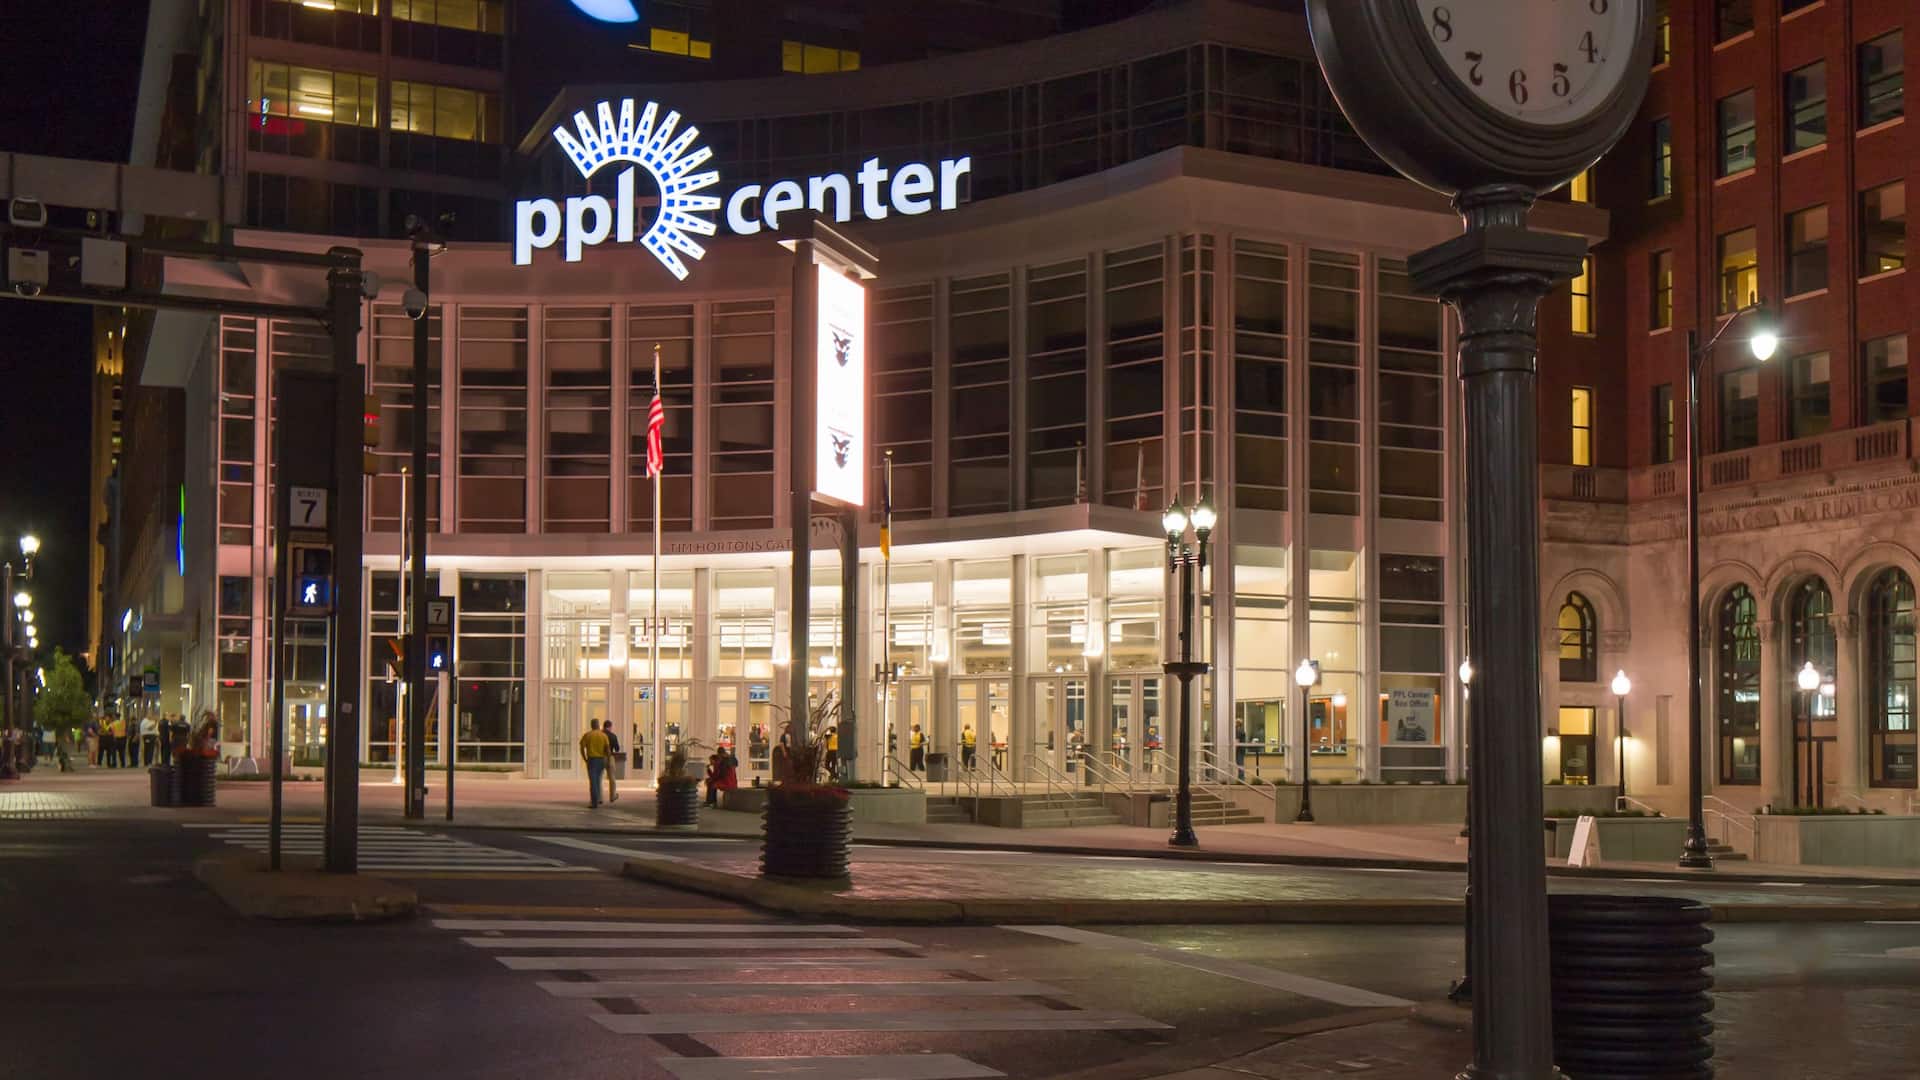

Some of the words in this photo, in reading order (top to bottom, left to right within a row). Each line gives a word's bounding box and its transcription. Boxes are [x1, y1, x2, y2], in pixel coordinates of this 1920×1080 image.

[1432, 6, 1453, 42] 8
[1578, 30, 1597, 63] 4
[1465, 51, 1483, 86] 7
[1552, 63, 1570, 97] 5
[1509, 69, 1528, 105] 6
[514, 166, 634, 265] ppl
[727, 156, 971, 235] center
[300, 500, 317, 524] 7
[671, 543, 692, 553] TIM
[697, 540, 763, 552] HORTONS
[766, 539, 793, 550] GAT
[433, 608, 443, 622] 7
[1409, 700, 1429, 708] Office
